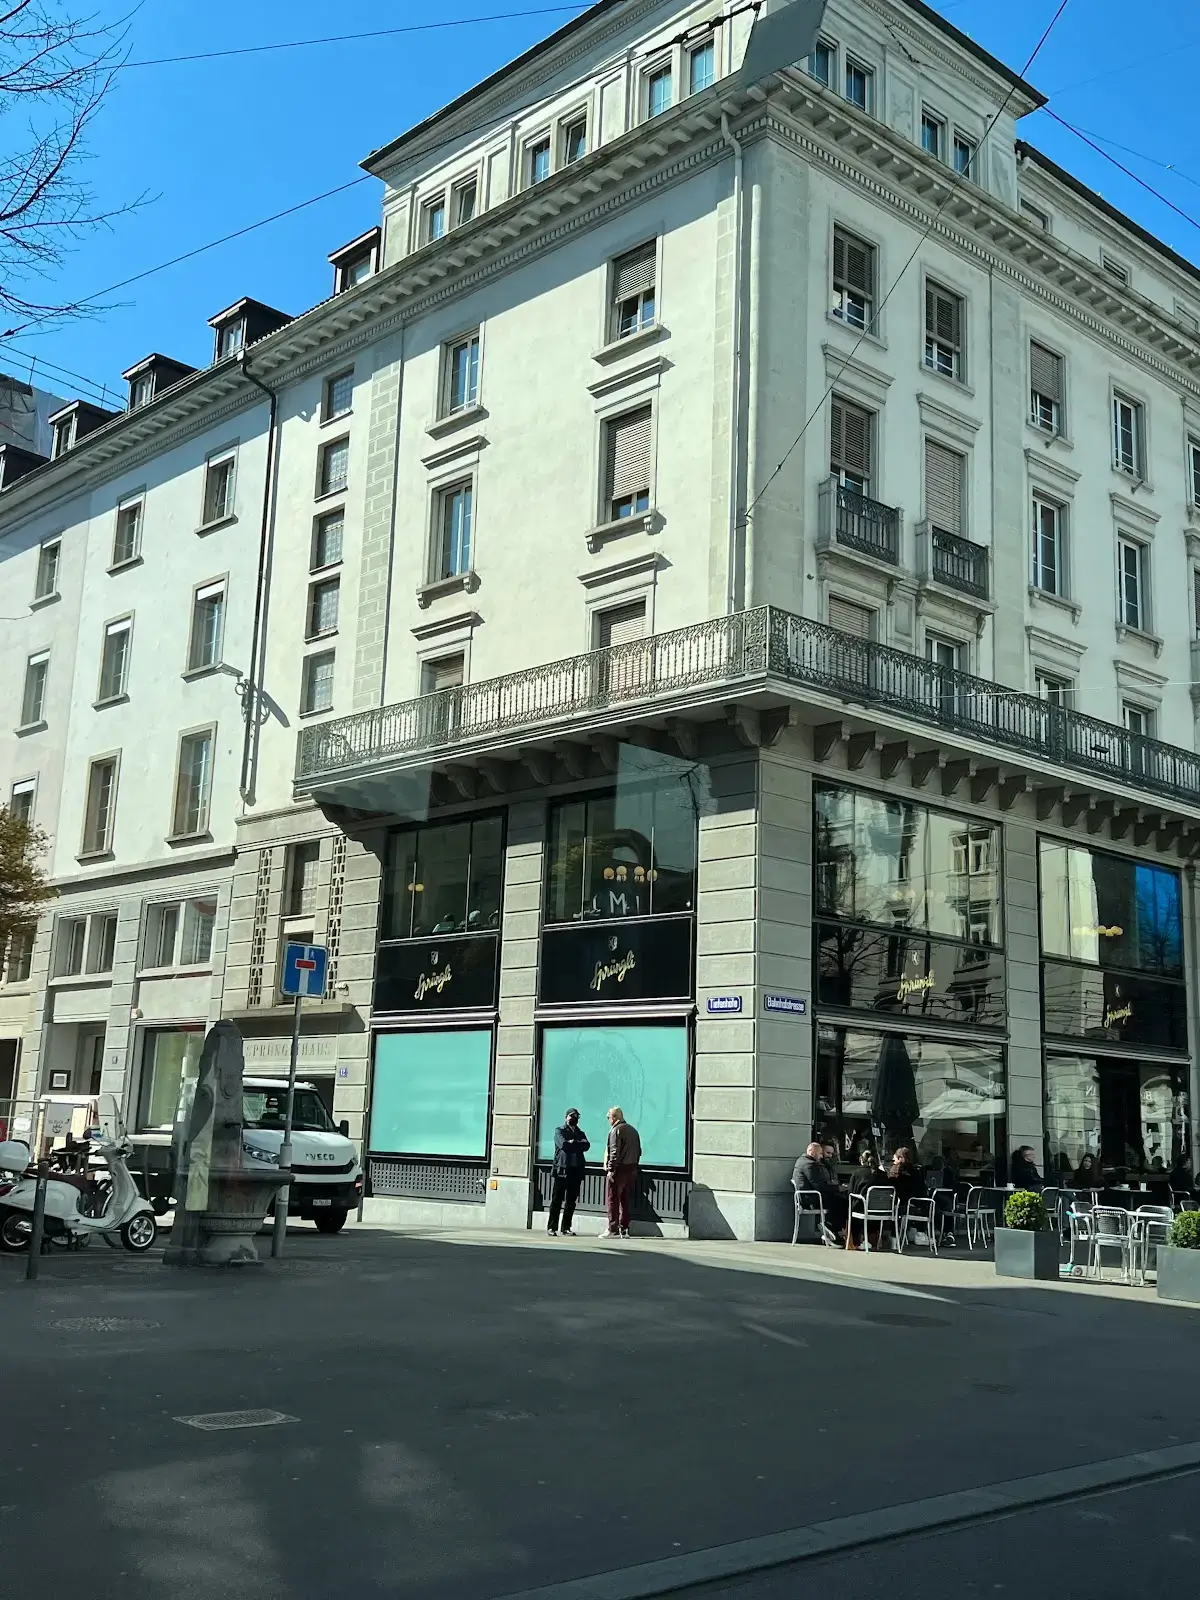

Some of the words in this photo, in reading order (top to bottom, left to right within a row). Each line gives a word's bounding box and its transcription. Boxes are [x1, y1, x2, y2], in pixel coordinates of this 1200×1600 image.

[414, 963, 453, 1000] Sprüngli
[589, 949, 636, 991] Sprüngli
[245, 1042, 332, 1057] SPRÜNGHAUS
[304, 1153, 335, 1161] IVECO
